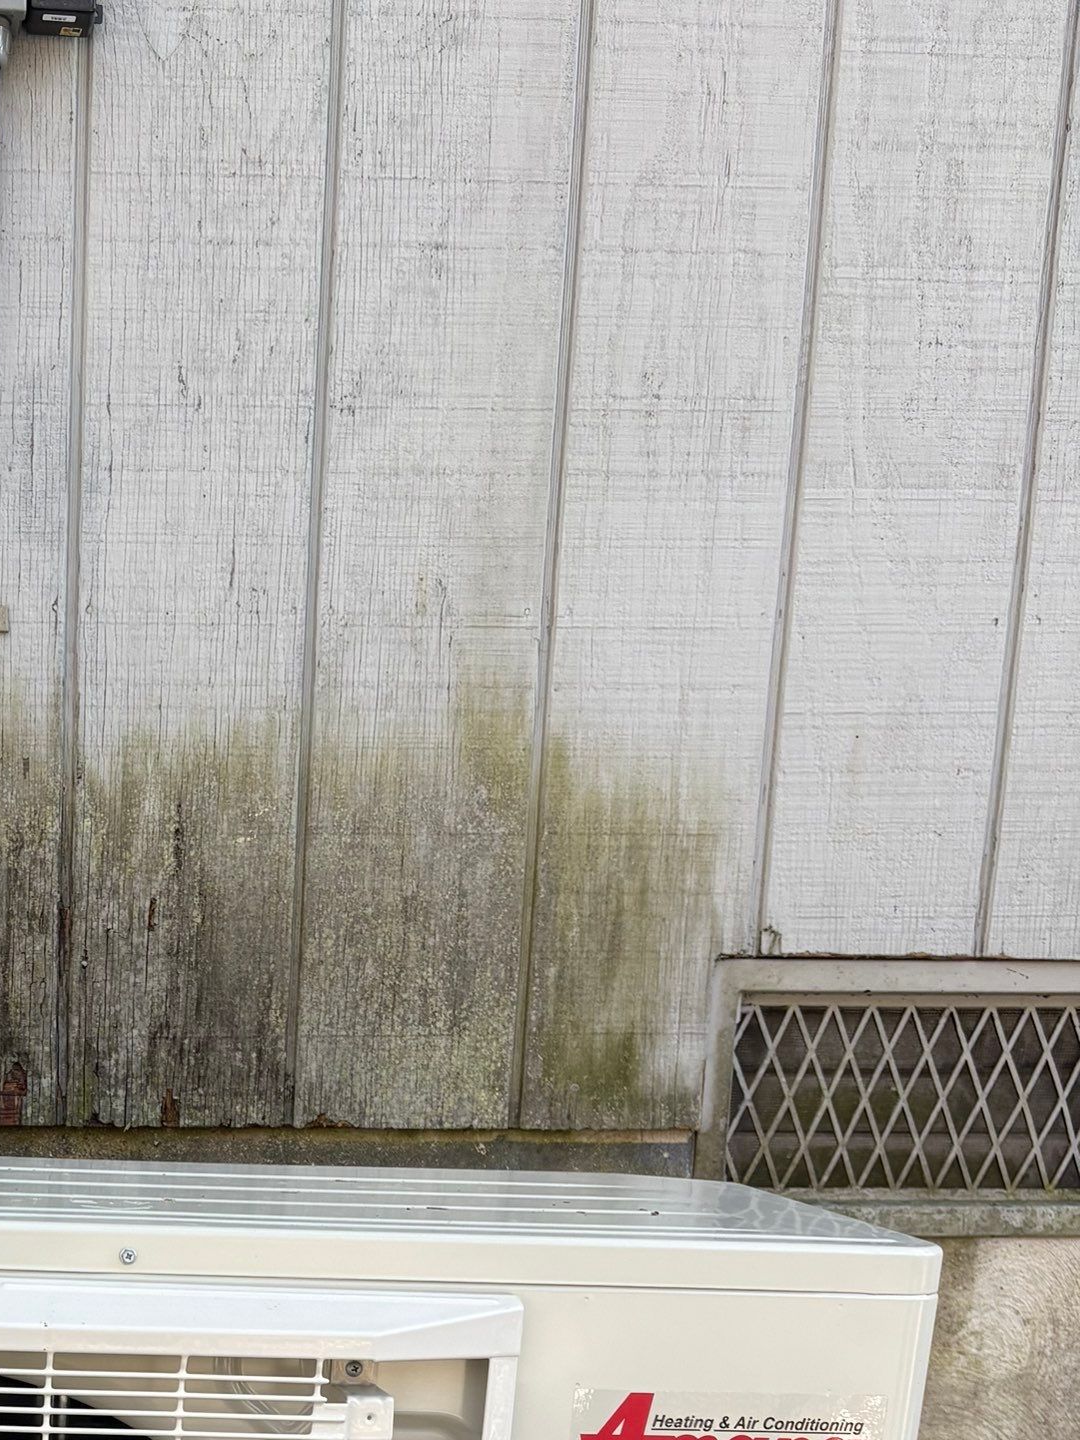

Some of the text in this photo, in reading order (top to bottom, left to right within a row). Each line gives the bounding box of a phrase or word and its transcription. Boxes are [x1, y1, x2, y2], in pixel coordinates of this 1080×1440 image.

[651, 1414, 864, 1434] Heating & Air Conditioning
